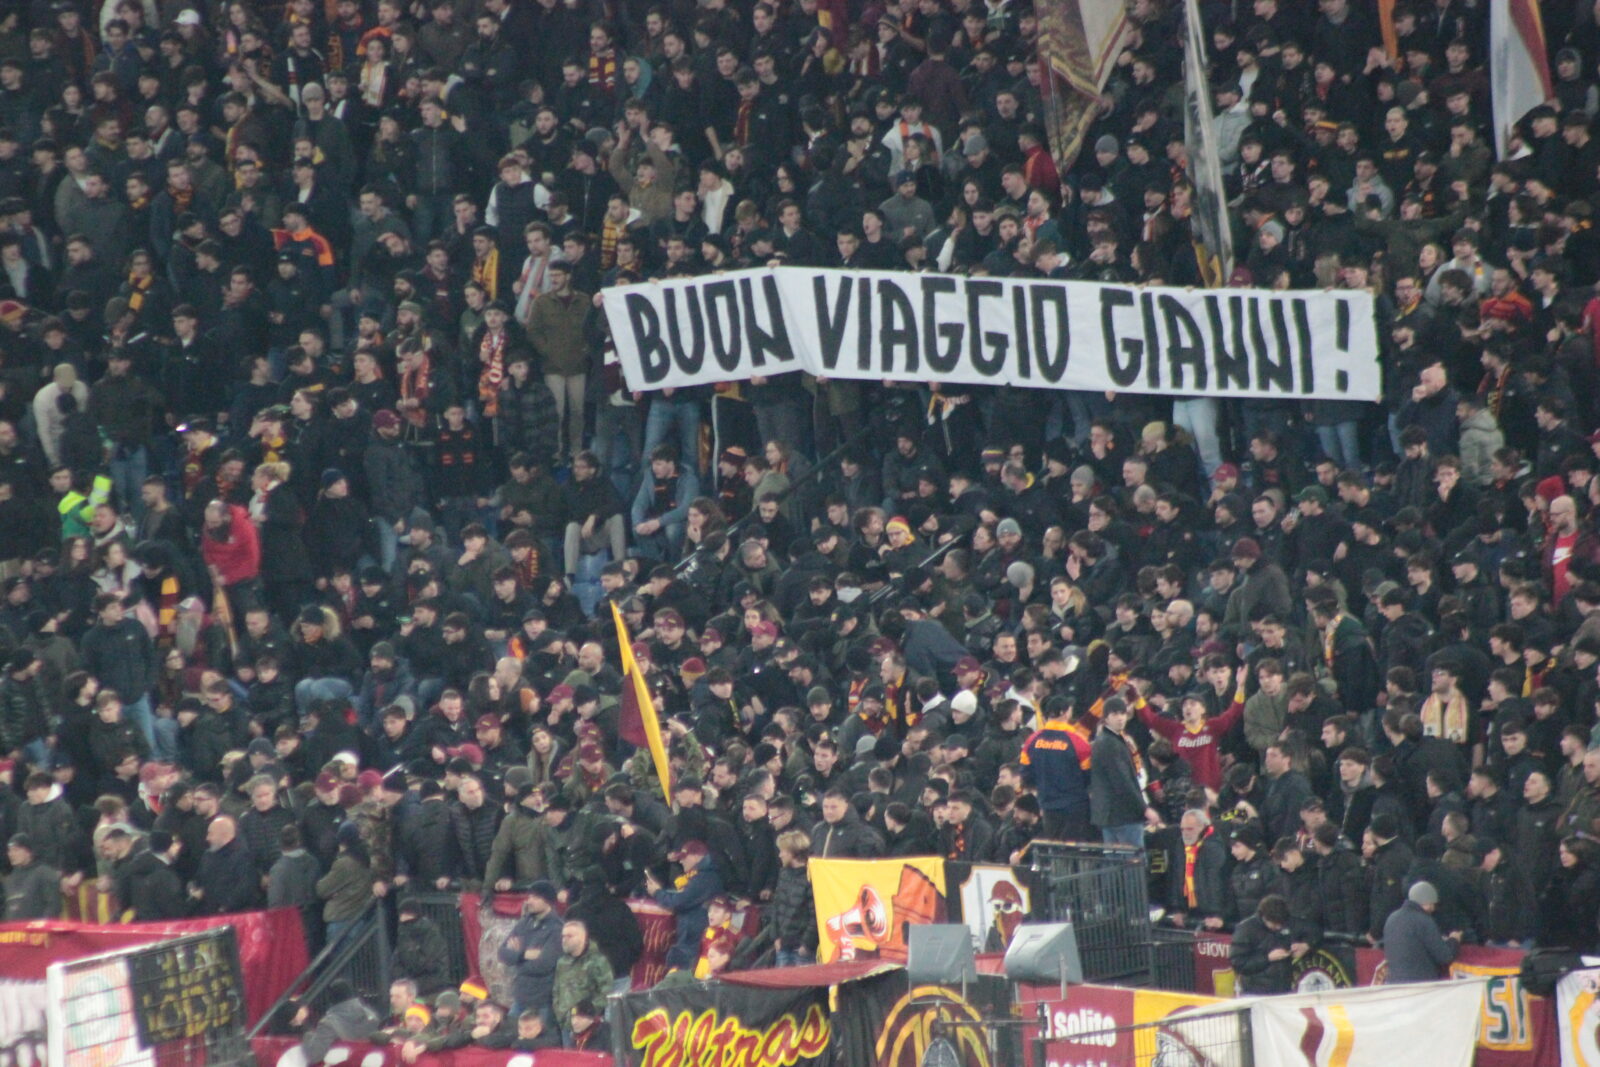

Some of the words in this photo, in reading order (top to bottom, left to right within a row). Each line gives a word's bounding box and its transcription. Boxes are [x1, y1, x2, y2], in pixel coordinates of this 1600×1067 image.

[624, 274, 795, 383] BUON
[812, 274, 1071, 383] VIAGGIO
[1178, 734, 1213, 748] Barilla
[631, 1003, 832, 1067] Ultras
